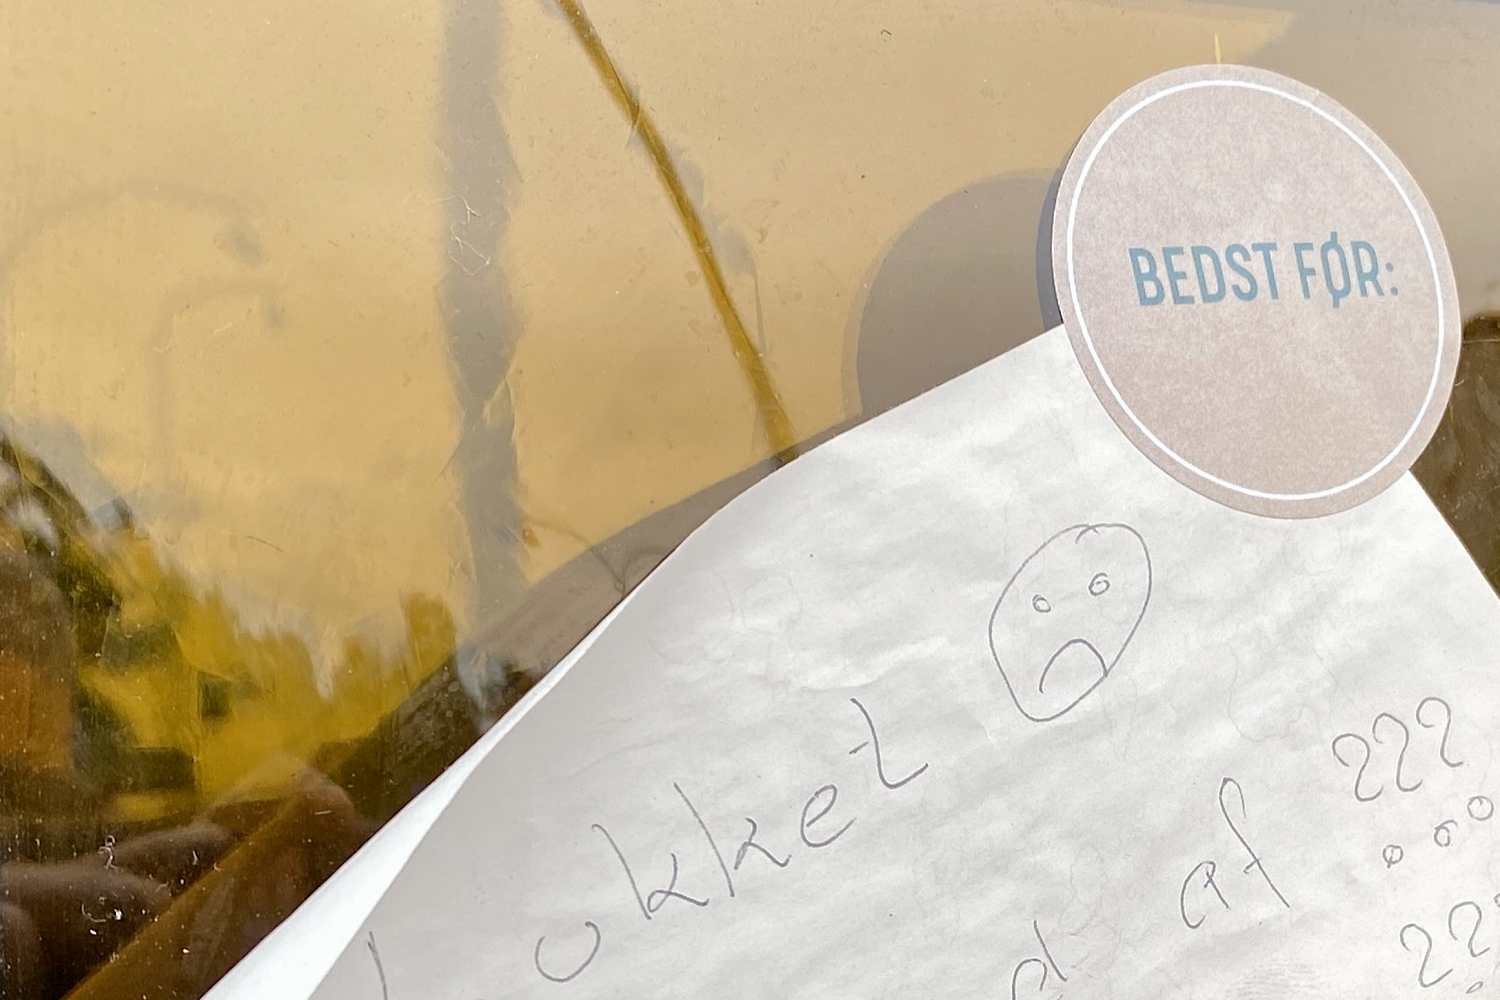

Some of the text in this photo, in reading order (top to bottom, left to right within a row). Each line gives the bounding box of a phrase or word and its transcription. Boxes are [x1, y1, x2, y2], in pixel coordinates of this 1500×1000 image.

[1128, 230, 1400, 309] BEDST FØR:
[1180, 777, 1290, 929] af
